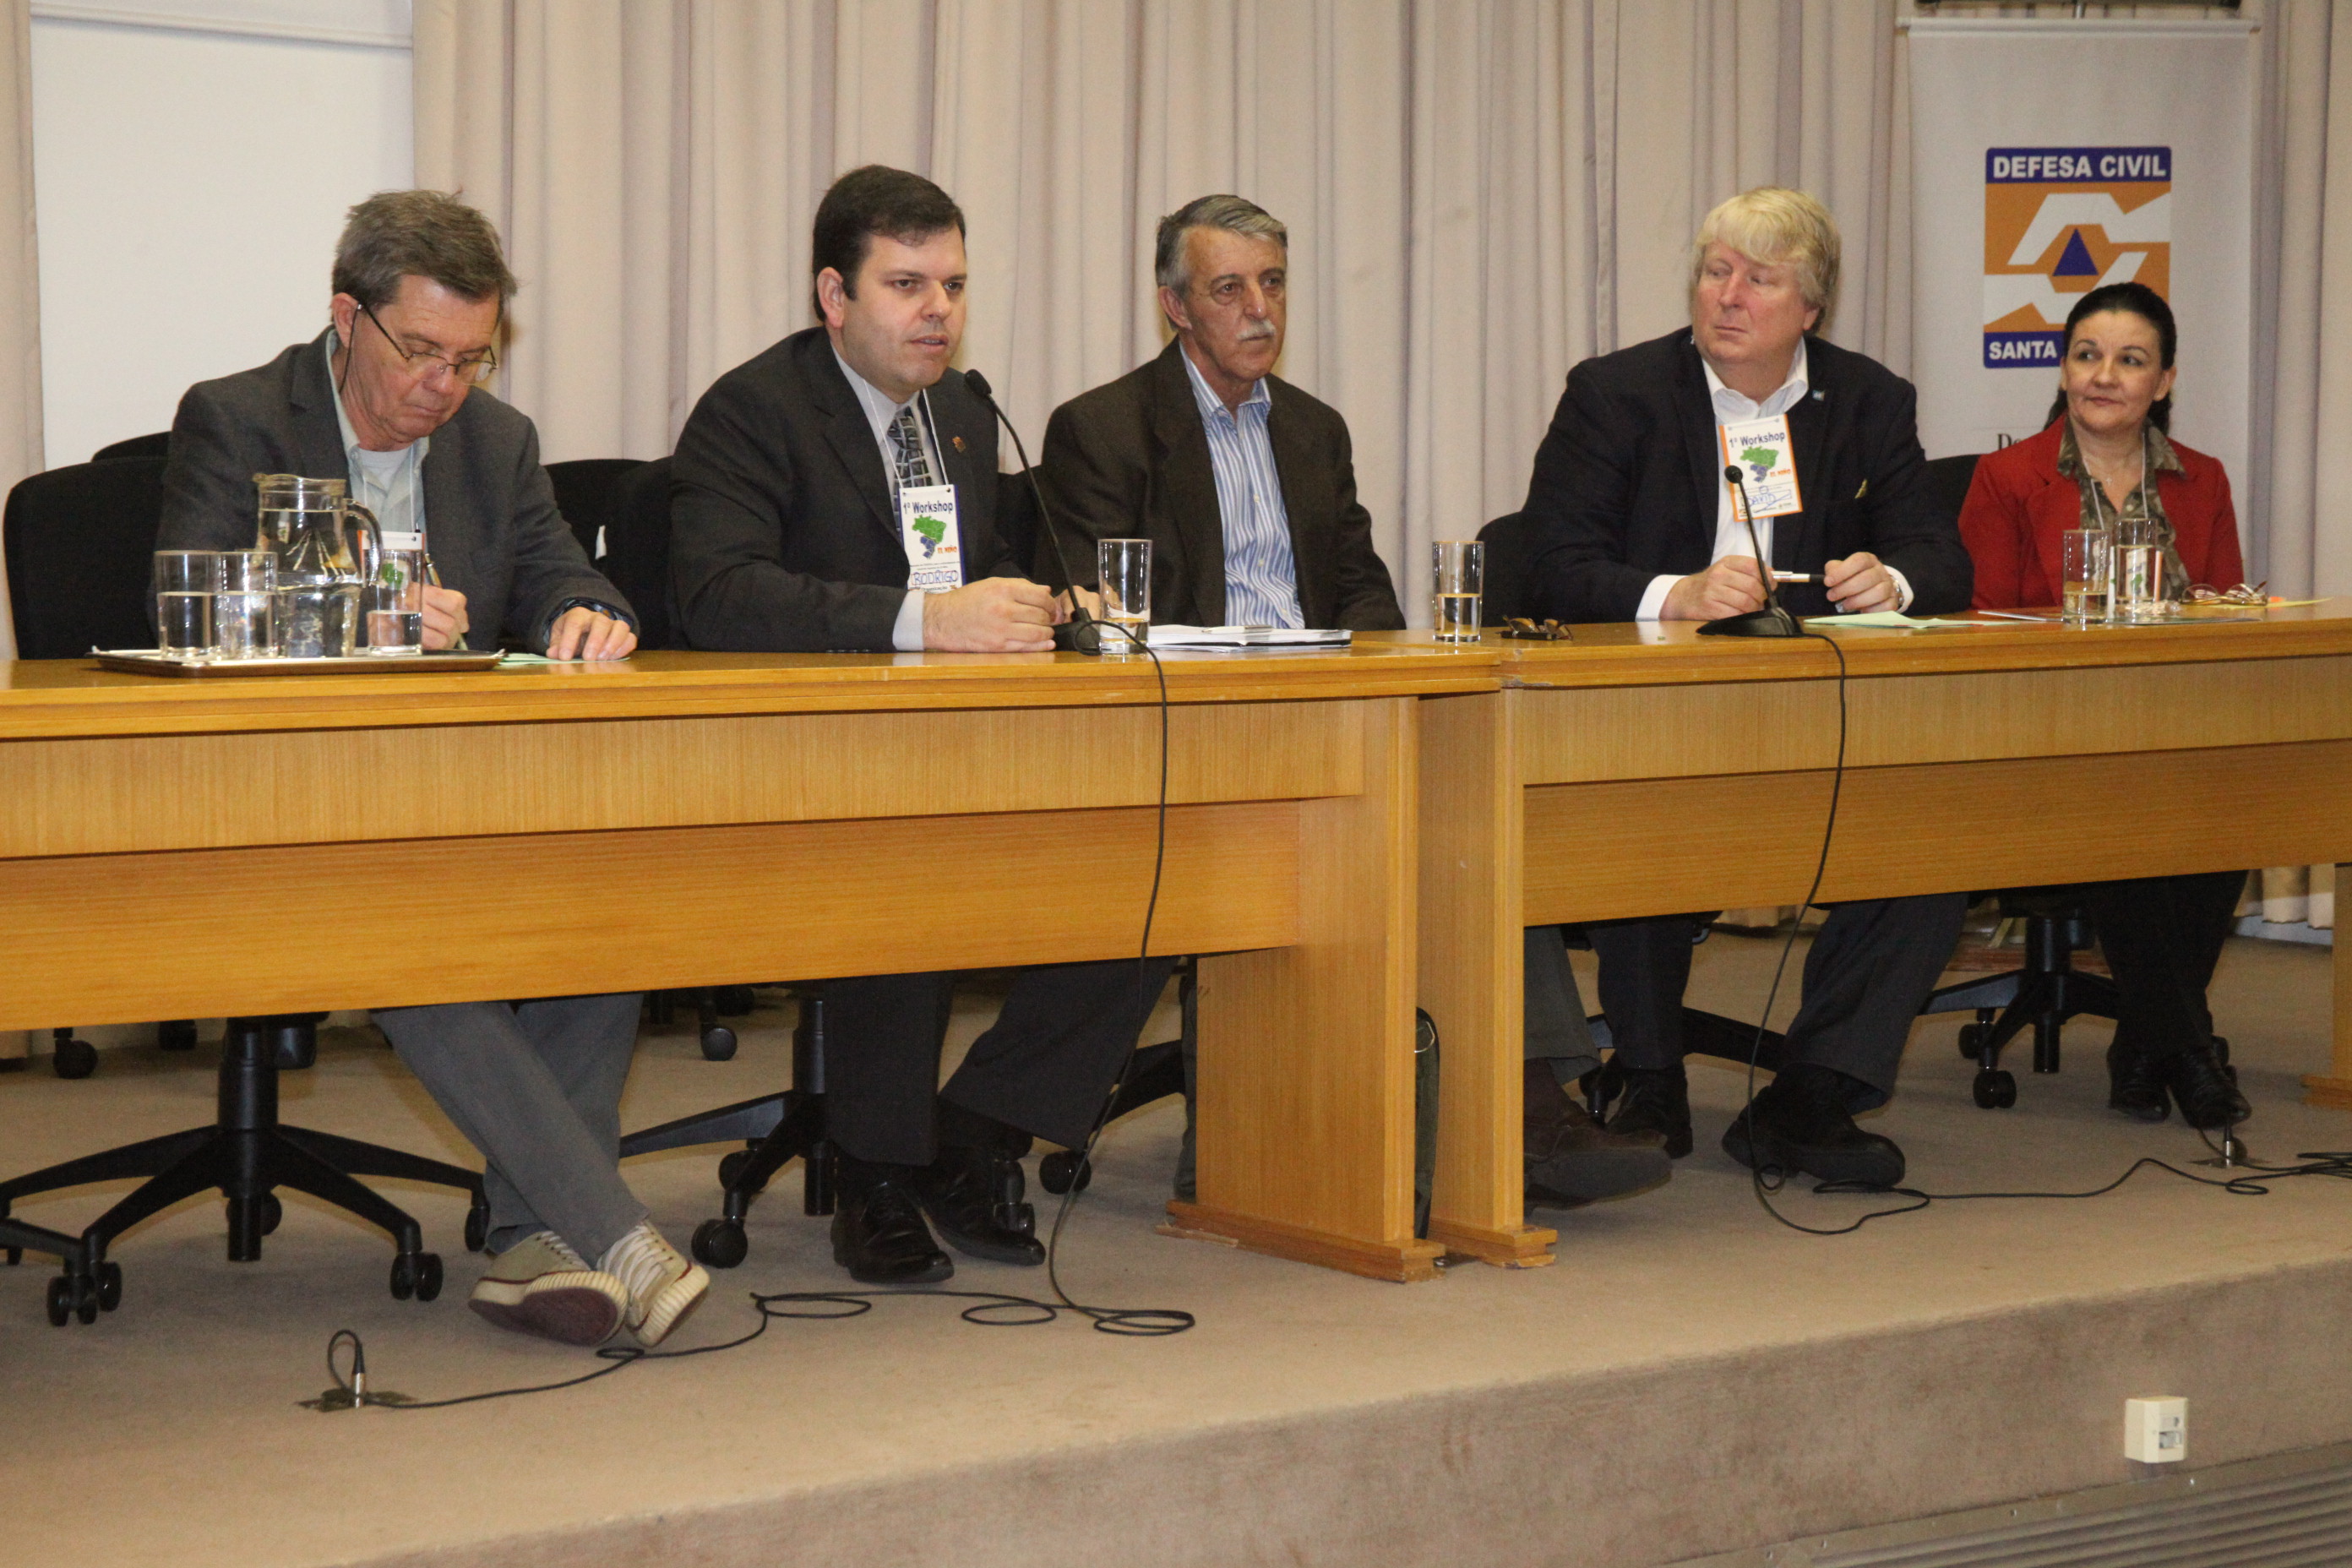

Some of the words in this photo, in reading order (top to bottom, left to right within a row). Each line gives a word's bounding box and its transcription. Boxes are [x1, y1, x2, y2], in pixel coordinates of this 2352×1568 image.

[1993, 155, 2092, 178] DEFESA
[2099, 155, 2166, 177] CIVIL
[1989, 340, 2057, 360] SANTA
[1740, 432, 1785, 445] Workshop
[912, 500, 953, 514] Workshop
[914, 569, 959, 585] RODRIGO
